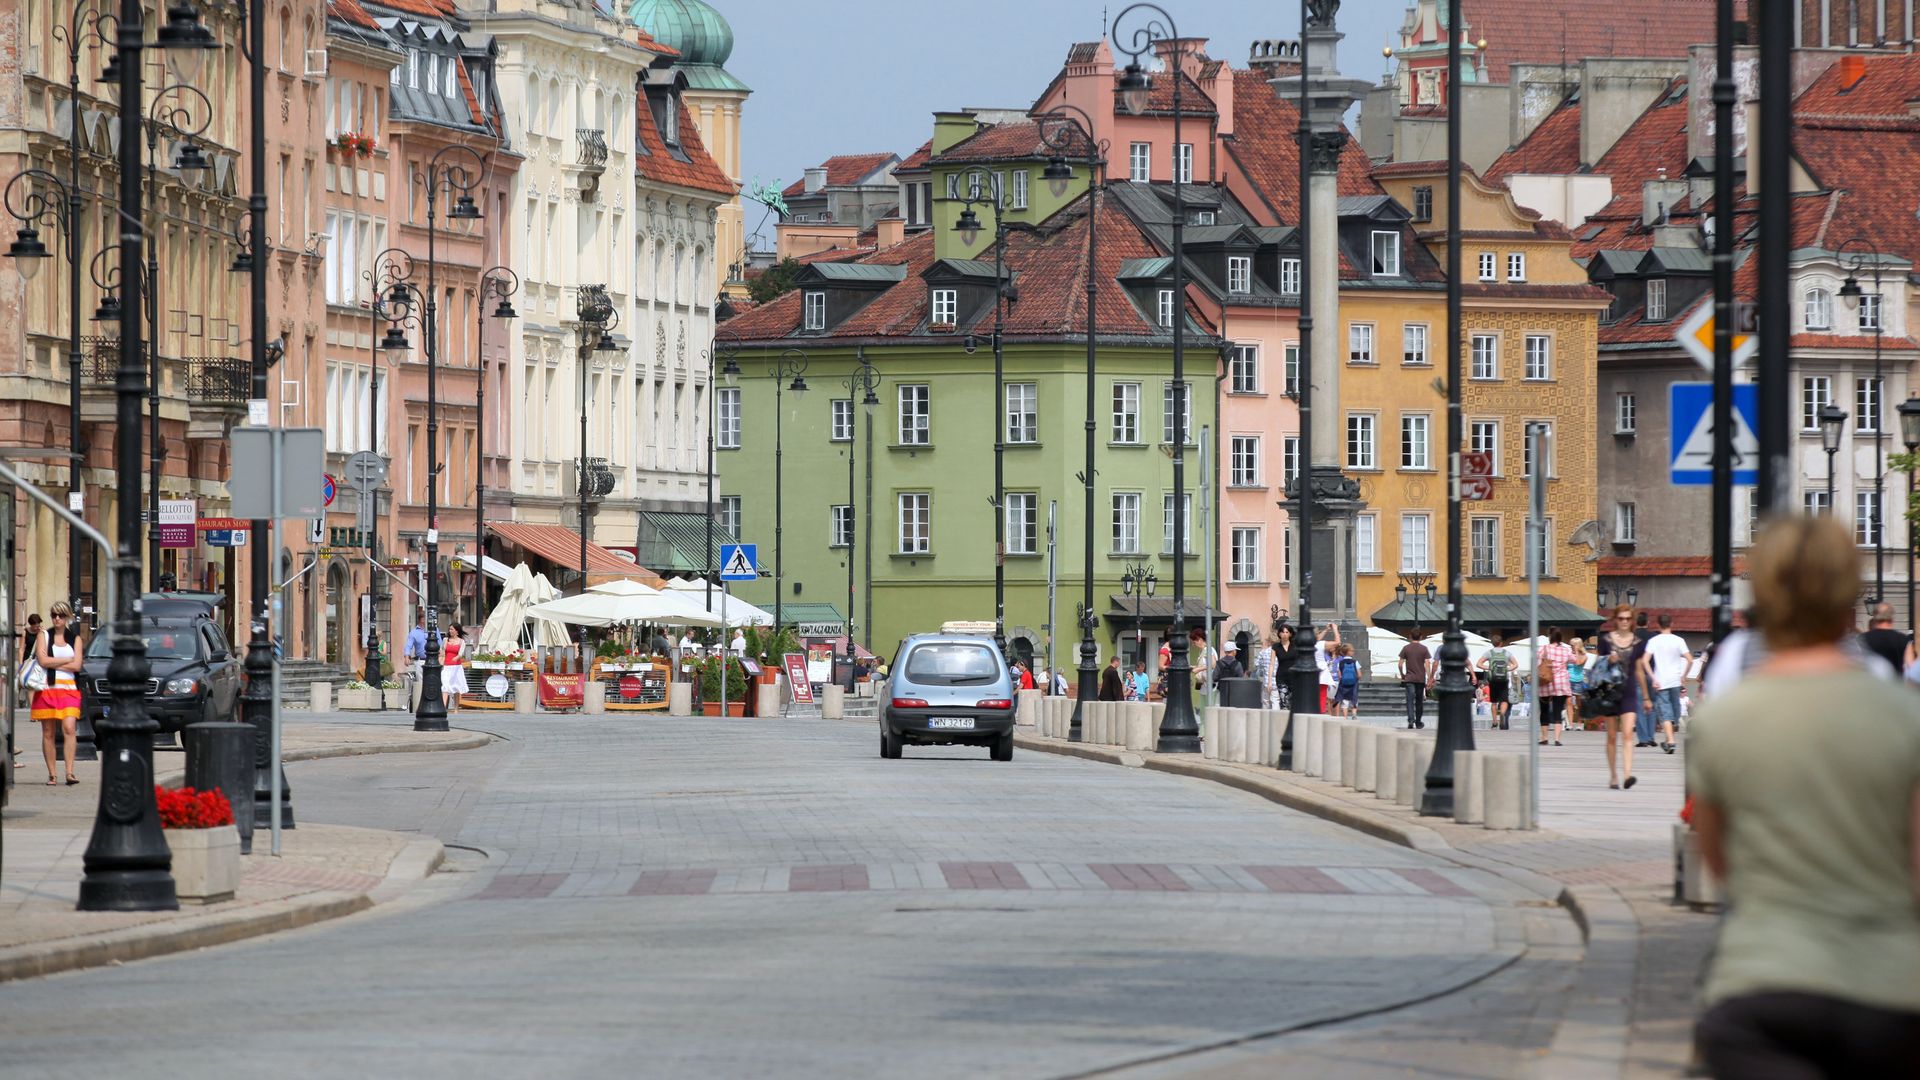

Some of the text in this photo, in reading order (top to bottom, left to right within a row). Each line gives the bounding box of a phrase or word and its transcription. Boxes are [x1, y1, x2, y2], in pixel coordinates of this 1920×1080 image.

[197, 519, 231, 529] STAURACJA
[933, 718, 973, 727] WN 32149
